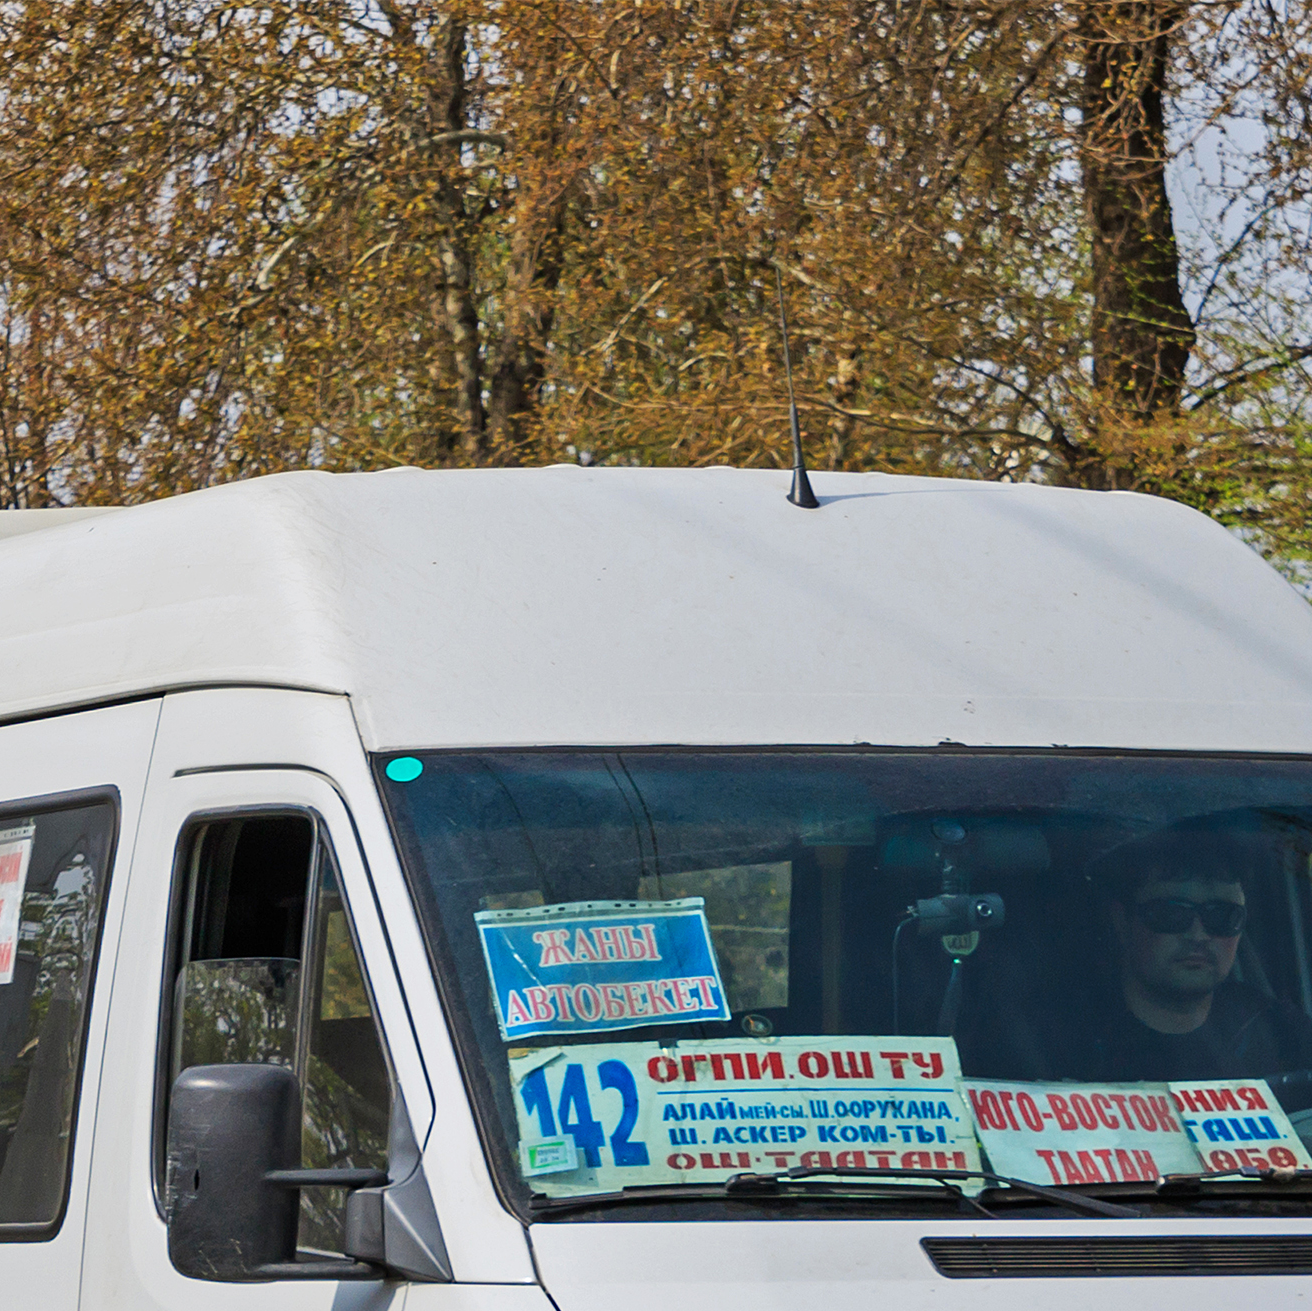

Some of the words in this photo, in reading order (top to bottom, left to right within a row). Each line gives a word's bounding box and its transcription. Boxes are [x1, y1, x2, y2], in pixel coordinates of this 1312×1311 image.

[532, 923, 662, 967] ЖАНЫ
[505, 975, 719, 1028] АВТОБЕКЕТ
[879, 1051, 945, 1080] ТУ
[520, 1059, 650, 1168] 142
[662, 1097, 737, 1121] АЛАЙ
[968, 1089, 1181, 1132] ЮГО-ВОСТОК
[713, 1125, 807, 1144] АСКЕР
[1036, 1149, 1160, 1185] ТААТАН
